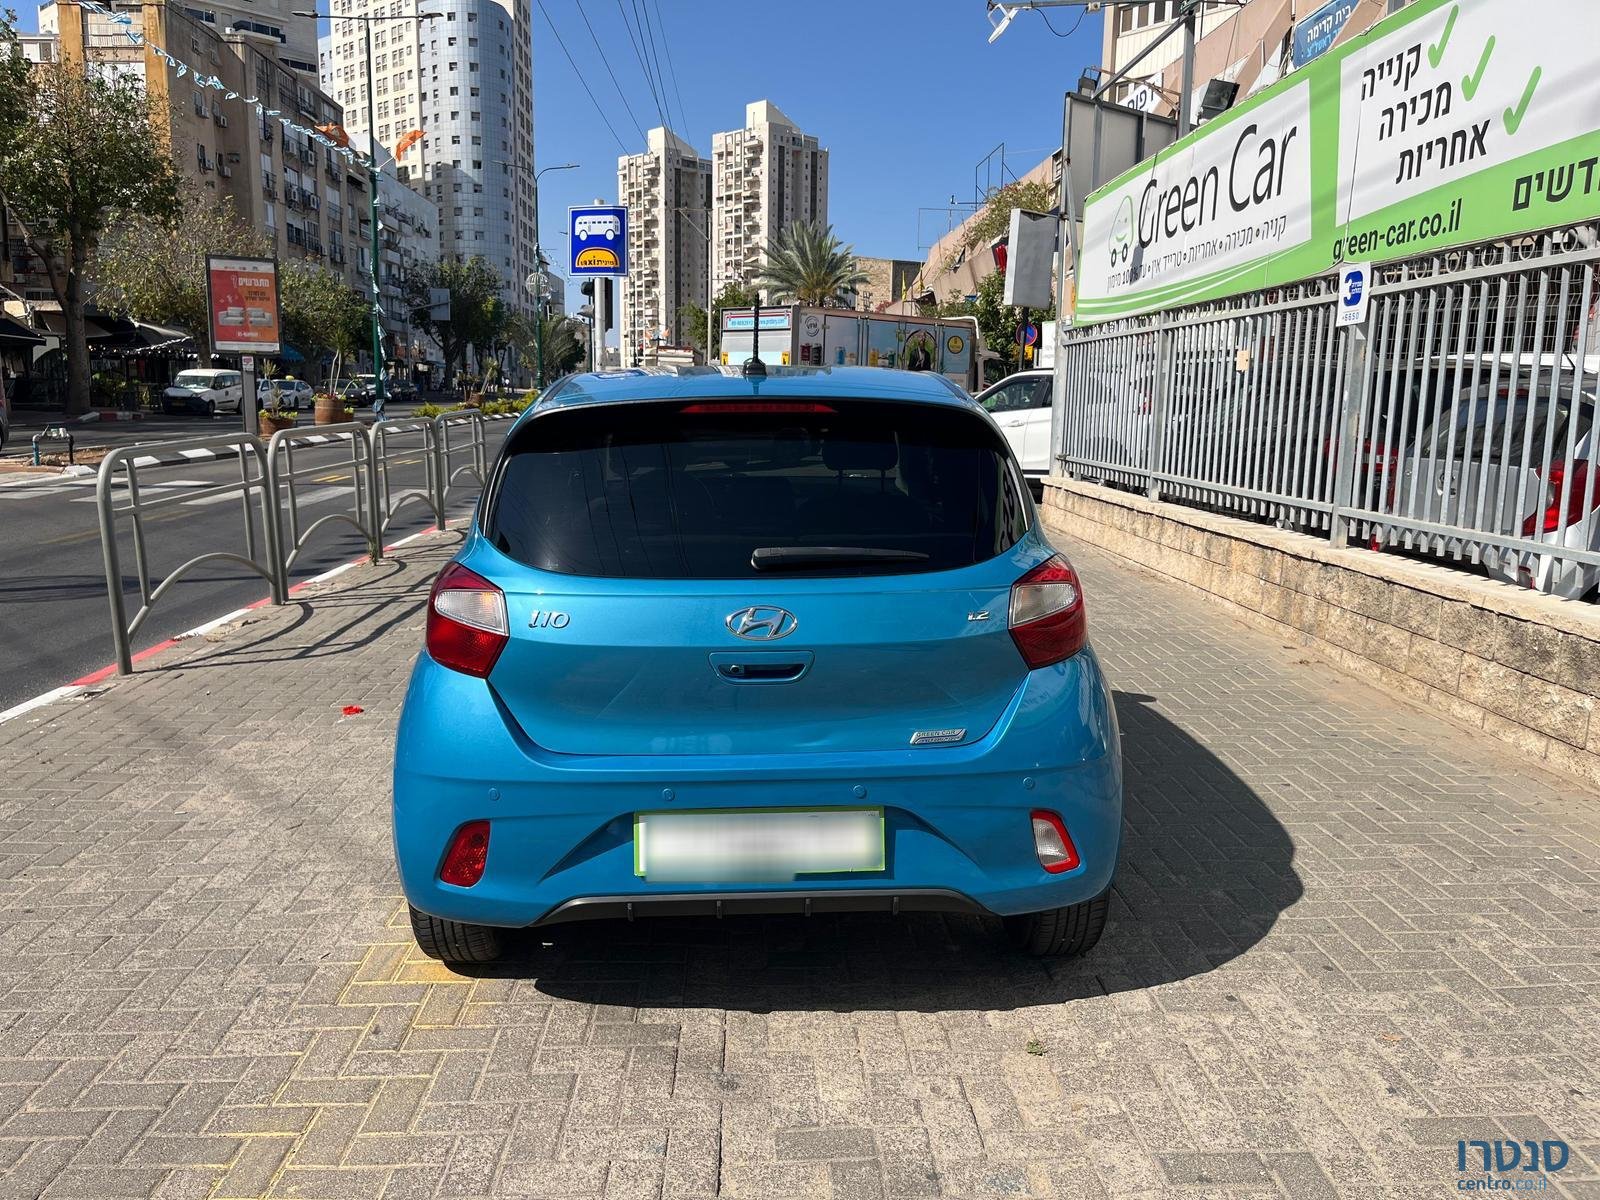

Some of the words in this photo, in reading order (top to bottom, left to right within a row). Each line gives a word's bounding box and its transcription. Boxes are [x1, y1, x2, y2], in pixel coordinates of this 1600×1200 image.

[1307, 15, 1333, 42] קדימה
[1335, 5, 1352, 25] בית
[1361, 43, 1421, 101] קנייה
[1379, 82, 1451, 141] מכירה
[1396, 119, 1490, 184] אחריות
[1138, 166, 1219, 249] Green
[1229, 124, 1297, 212] Car
[1512, 157, 1600, 211] דשים
[1188, 239, 1218, 263] אחריות
[1225, 227, 1253, 251] מכירה
[1262, 215, 1287, 241] קניה
[1333, 198, 1462, 263] green-car.co.il
